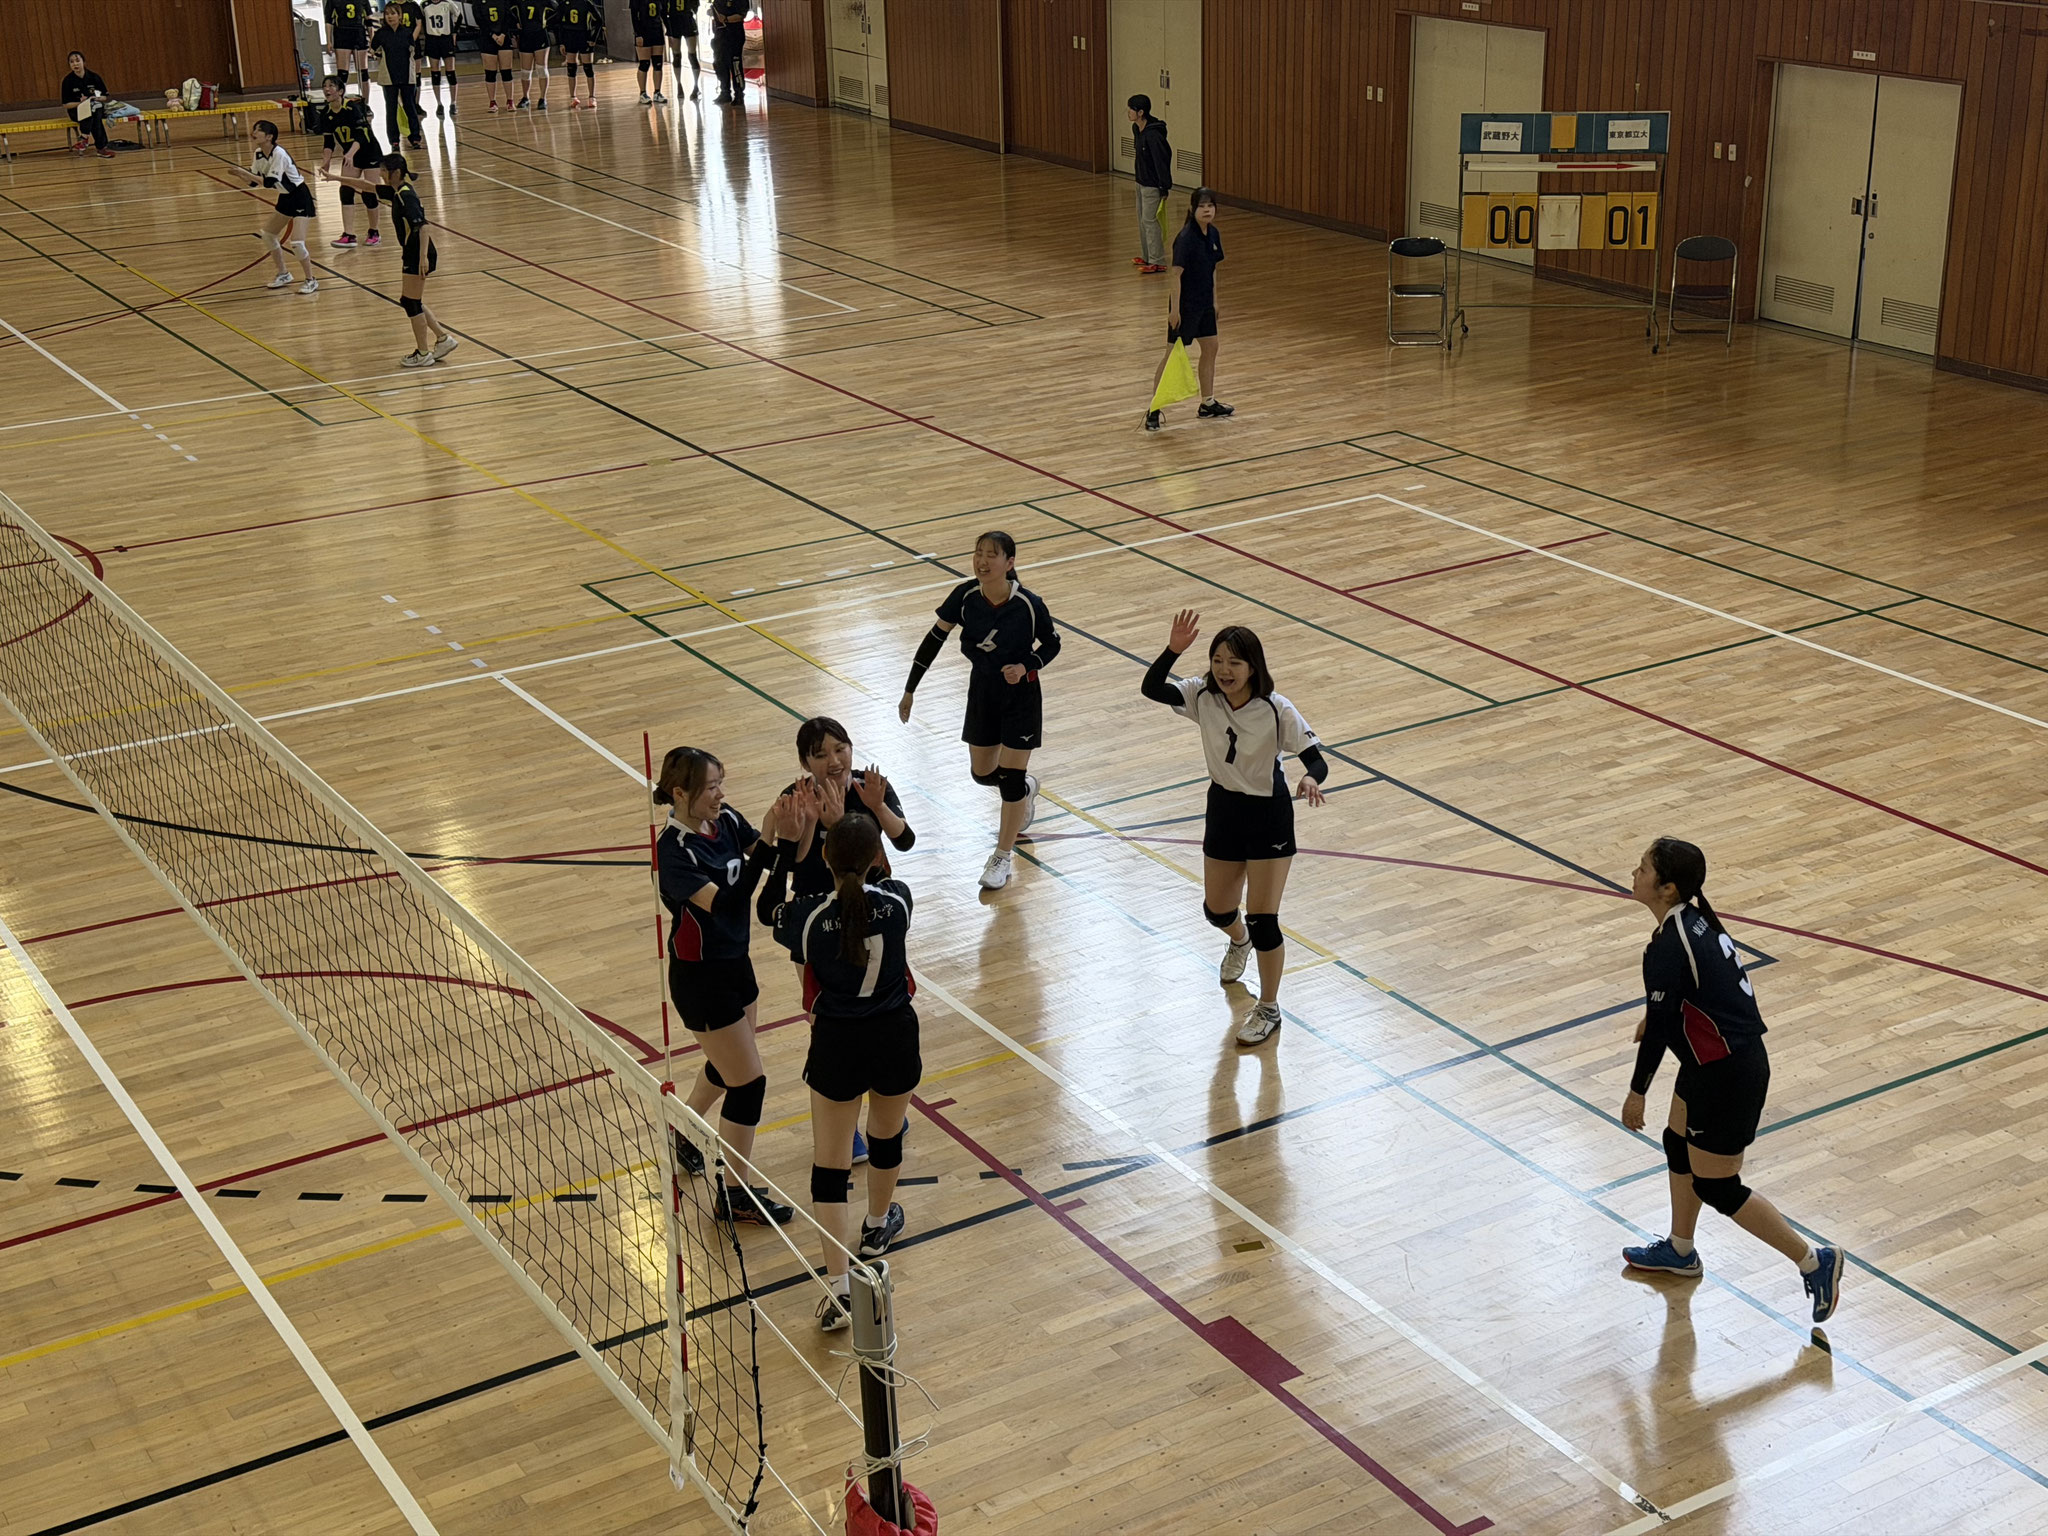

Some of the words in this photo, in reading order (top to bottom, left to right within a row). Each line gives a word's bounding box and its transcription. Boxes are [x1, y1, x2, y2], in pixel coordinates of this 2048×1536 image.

[346, 4, 355, 19] 3
[488, 7, 498, 22] 5
[527, 6, 535, 19] 7
[570, 9, 579, 23] 6
[648, 3, 657, 17] 8
[428, 15, 444, 28] 13
[335, 126, 355, 143] 12
[1483, 131, 1520, 141] 武蔵野大
[1609, 130, 1648, 139] 東京都立大
[1225, 726, 1238, 765] 1
[856, 933, 884, 998] 7
[1718, 933, 1753, 997] 3
